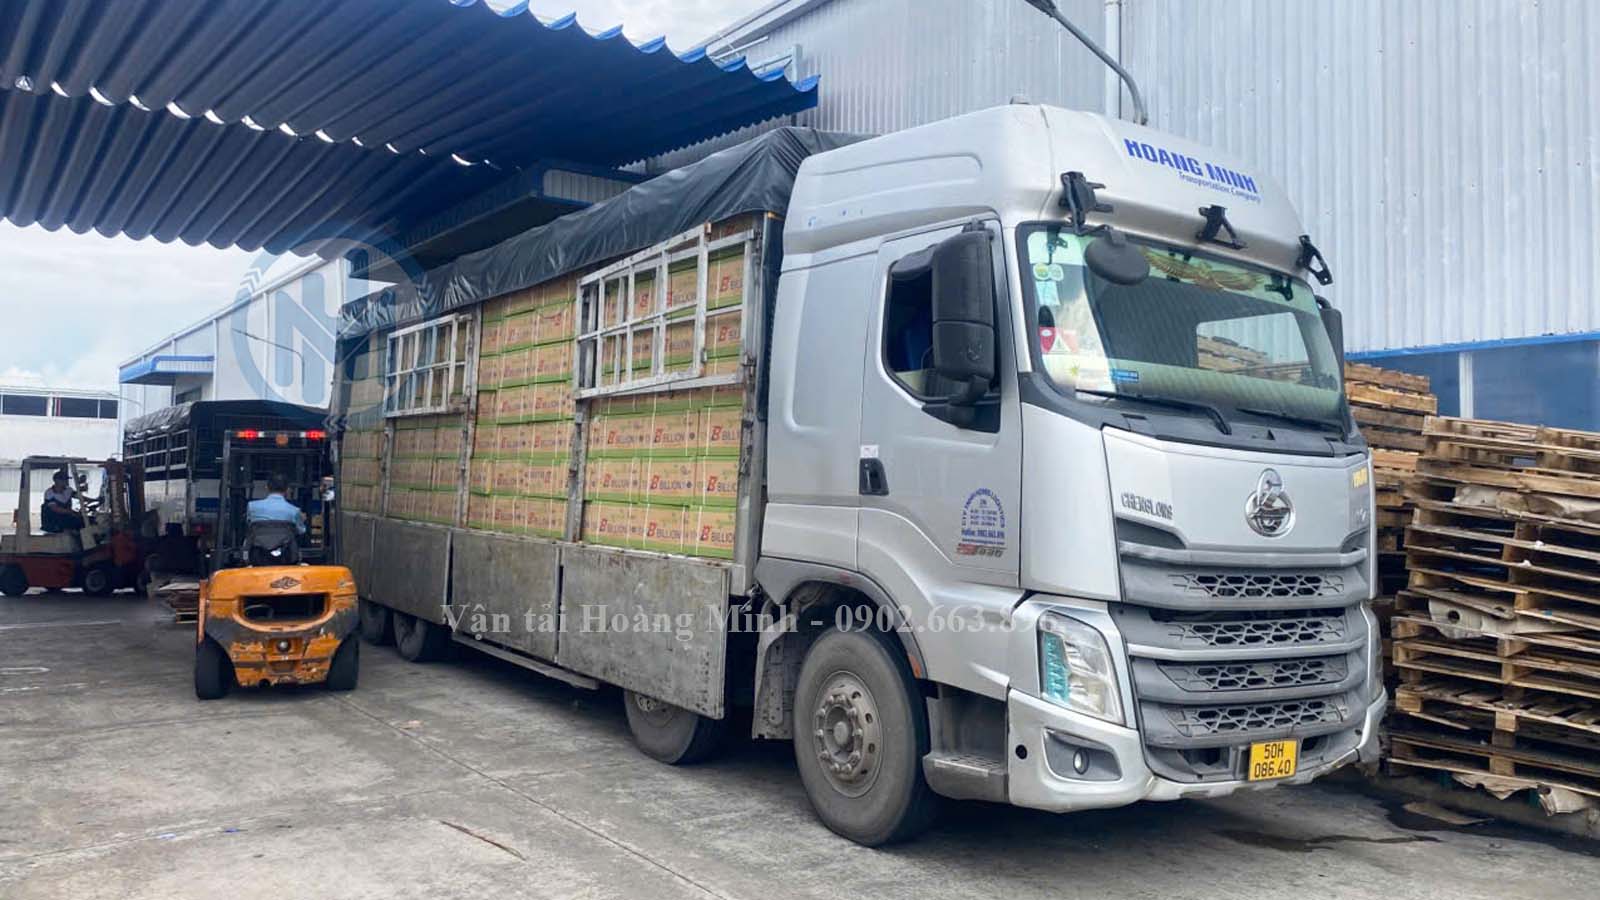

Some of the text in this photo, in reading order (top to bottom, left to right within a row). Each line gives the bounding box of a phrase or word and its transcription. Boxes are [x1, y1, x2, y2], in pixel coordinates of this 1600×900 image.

[1124, 138, 1258, 193] HOANG MINH
[1121, 492, 1173, 520] CHENGLONG
[1264, 743, 1284, 760] 50H
[1254, 759, 1291, 778] 086.40
